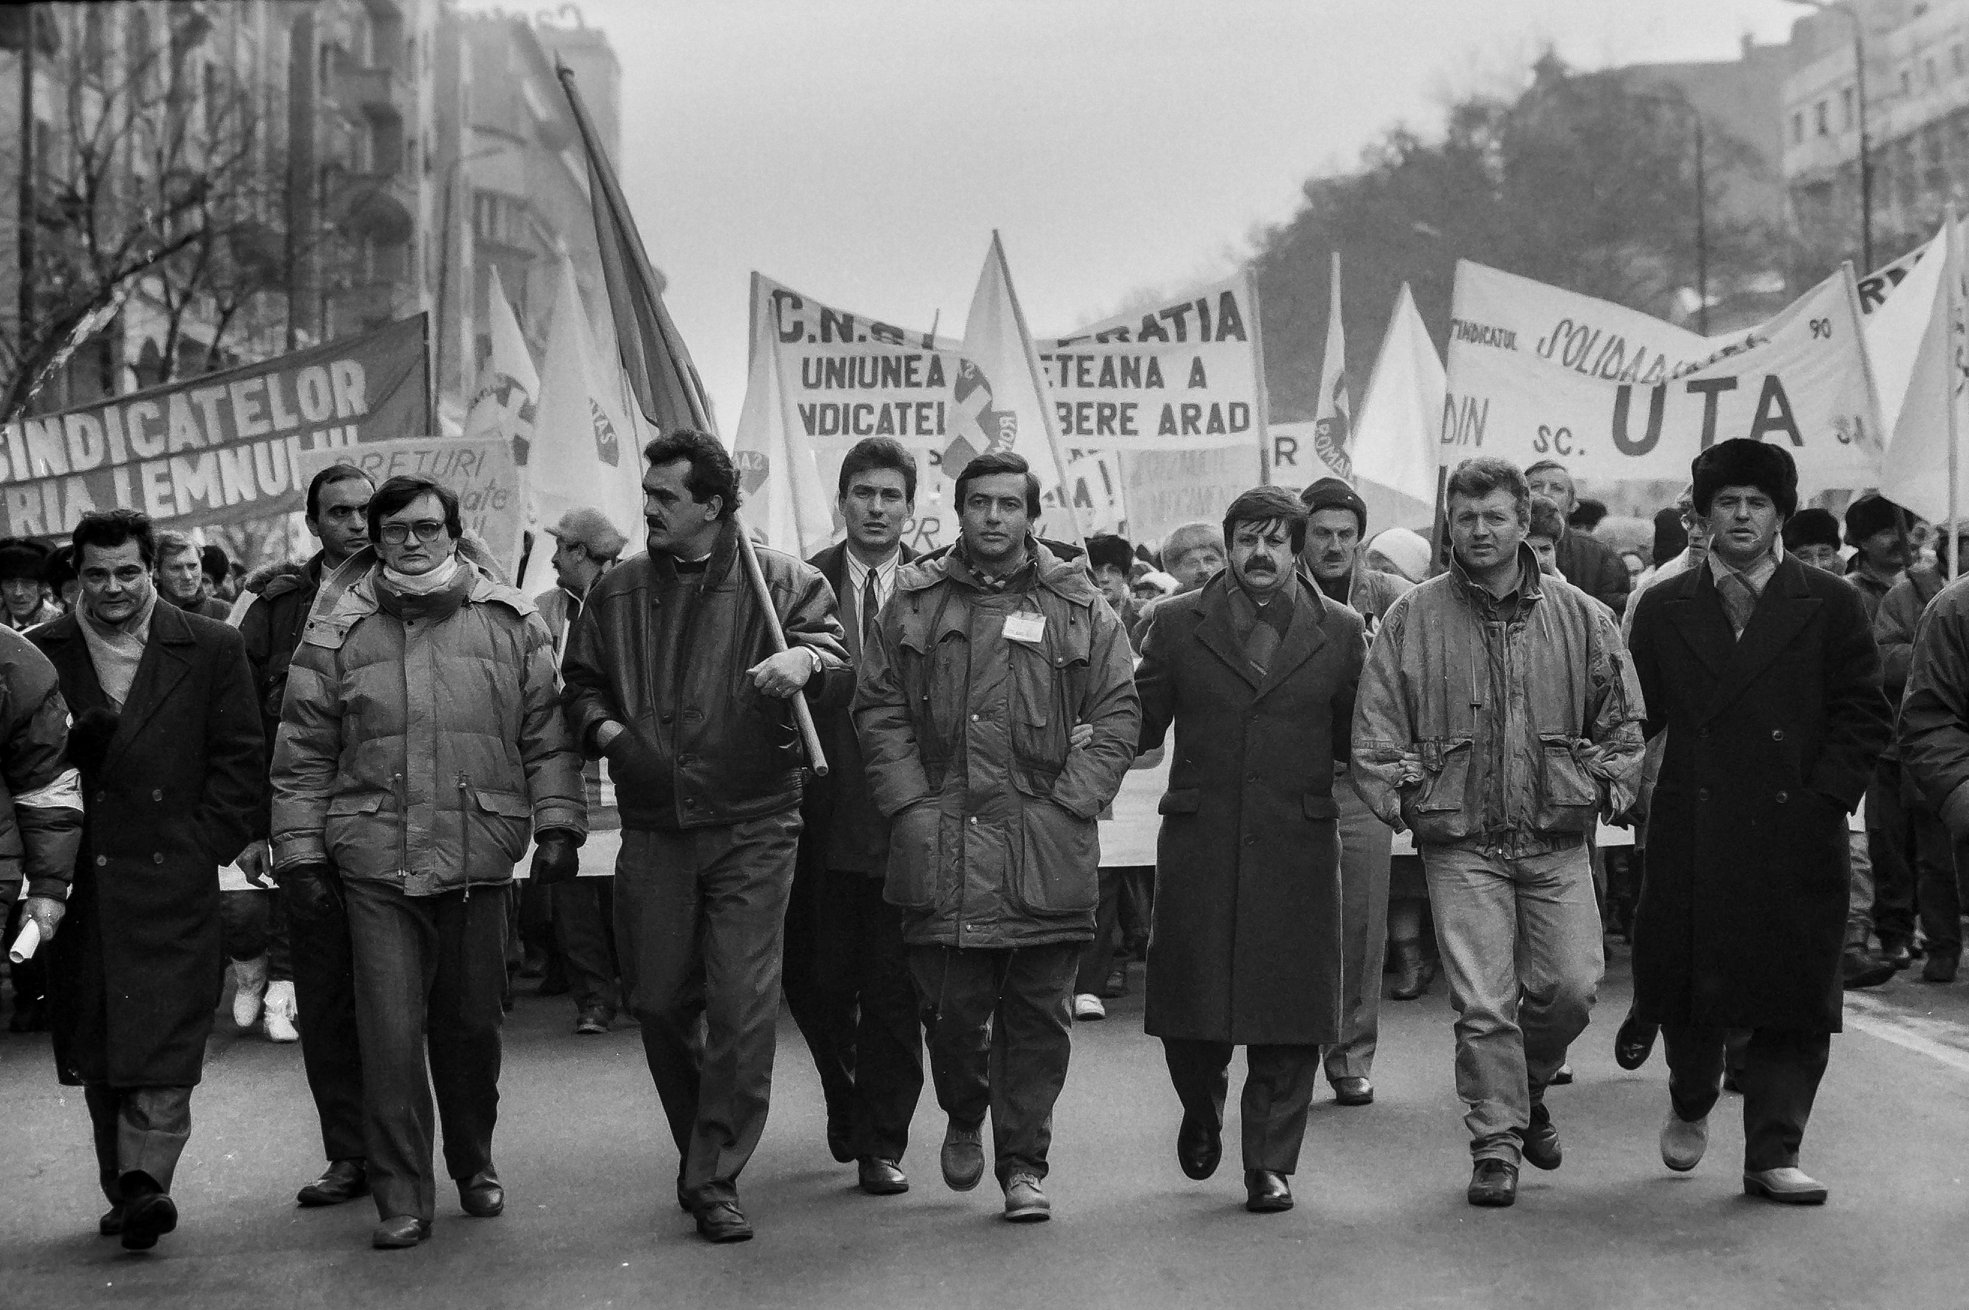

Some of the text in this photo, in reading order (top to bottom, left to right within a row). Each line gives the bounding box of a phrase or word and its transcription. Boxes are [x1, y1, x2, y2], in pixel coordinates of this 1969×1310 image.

[1809, 317, 1832, 340] 90
[802, 354, 946, 389] UNIUNEA
[1188, 355, 1207, 389] A
[1158, 402, 1250, 436] ARAD
[1441, 393, 1489, 447] DIN
[1612, 374, 1804, 457] UTA
[335, 448, 487, 480] RETURI
